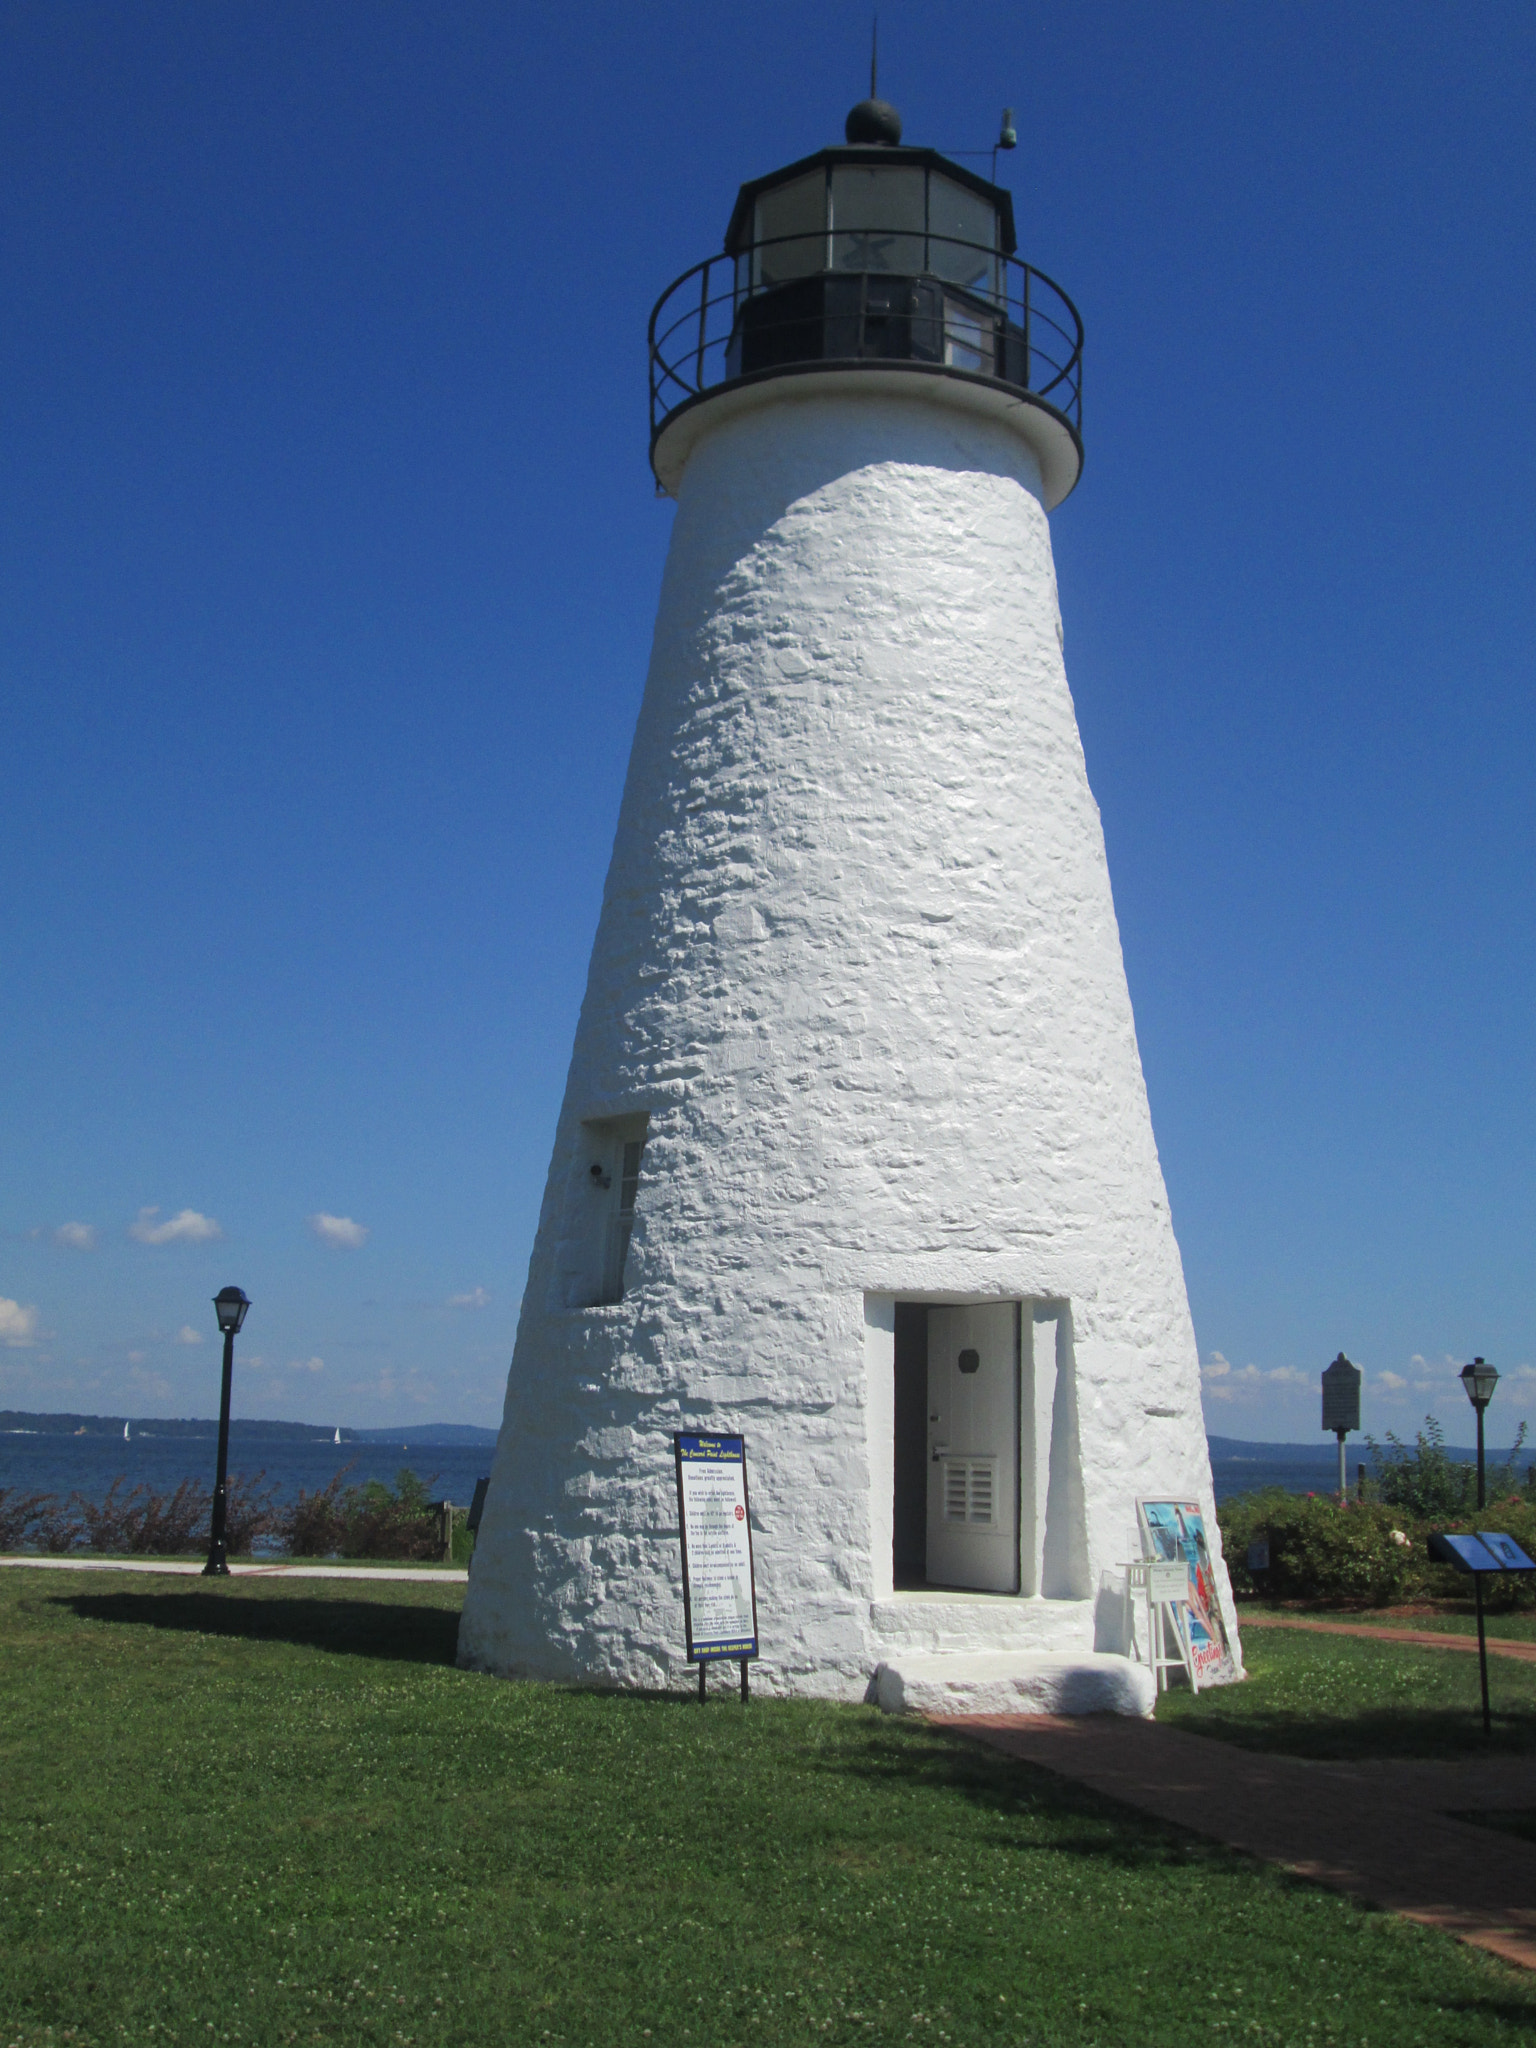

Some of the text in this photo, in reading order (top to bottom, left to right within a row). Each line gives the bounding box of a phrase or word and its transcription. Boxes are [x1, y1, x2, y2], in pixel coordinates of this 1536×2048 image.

[699, 1440, 716, 1448] Welcome
[689, 1449, 706, 1458] Concord
[707, 1449, 718, 1458] Point
[719, 1450, 740, 1459] Lighthouse
